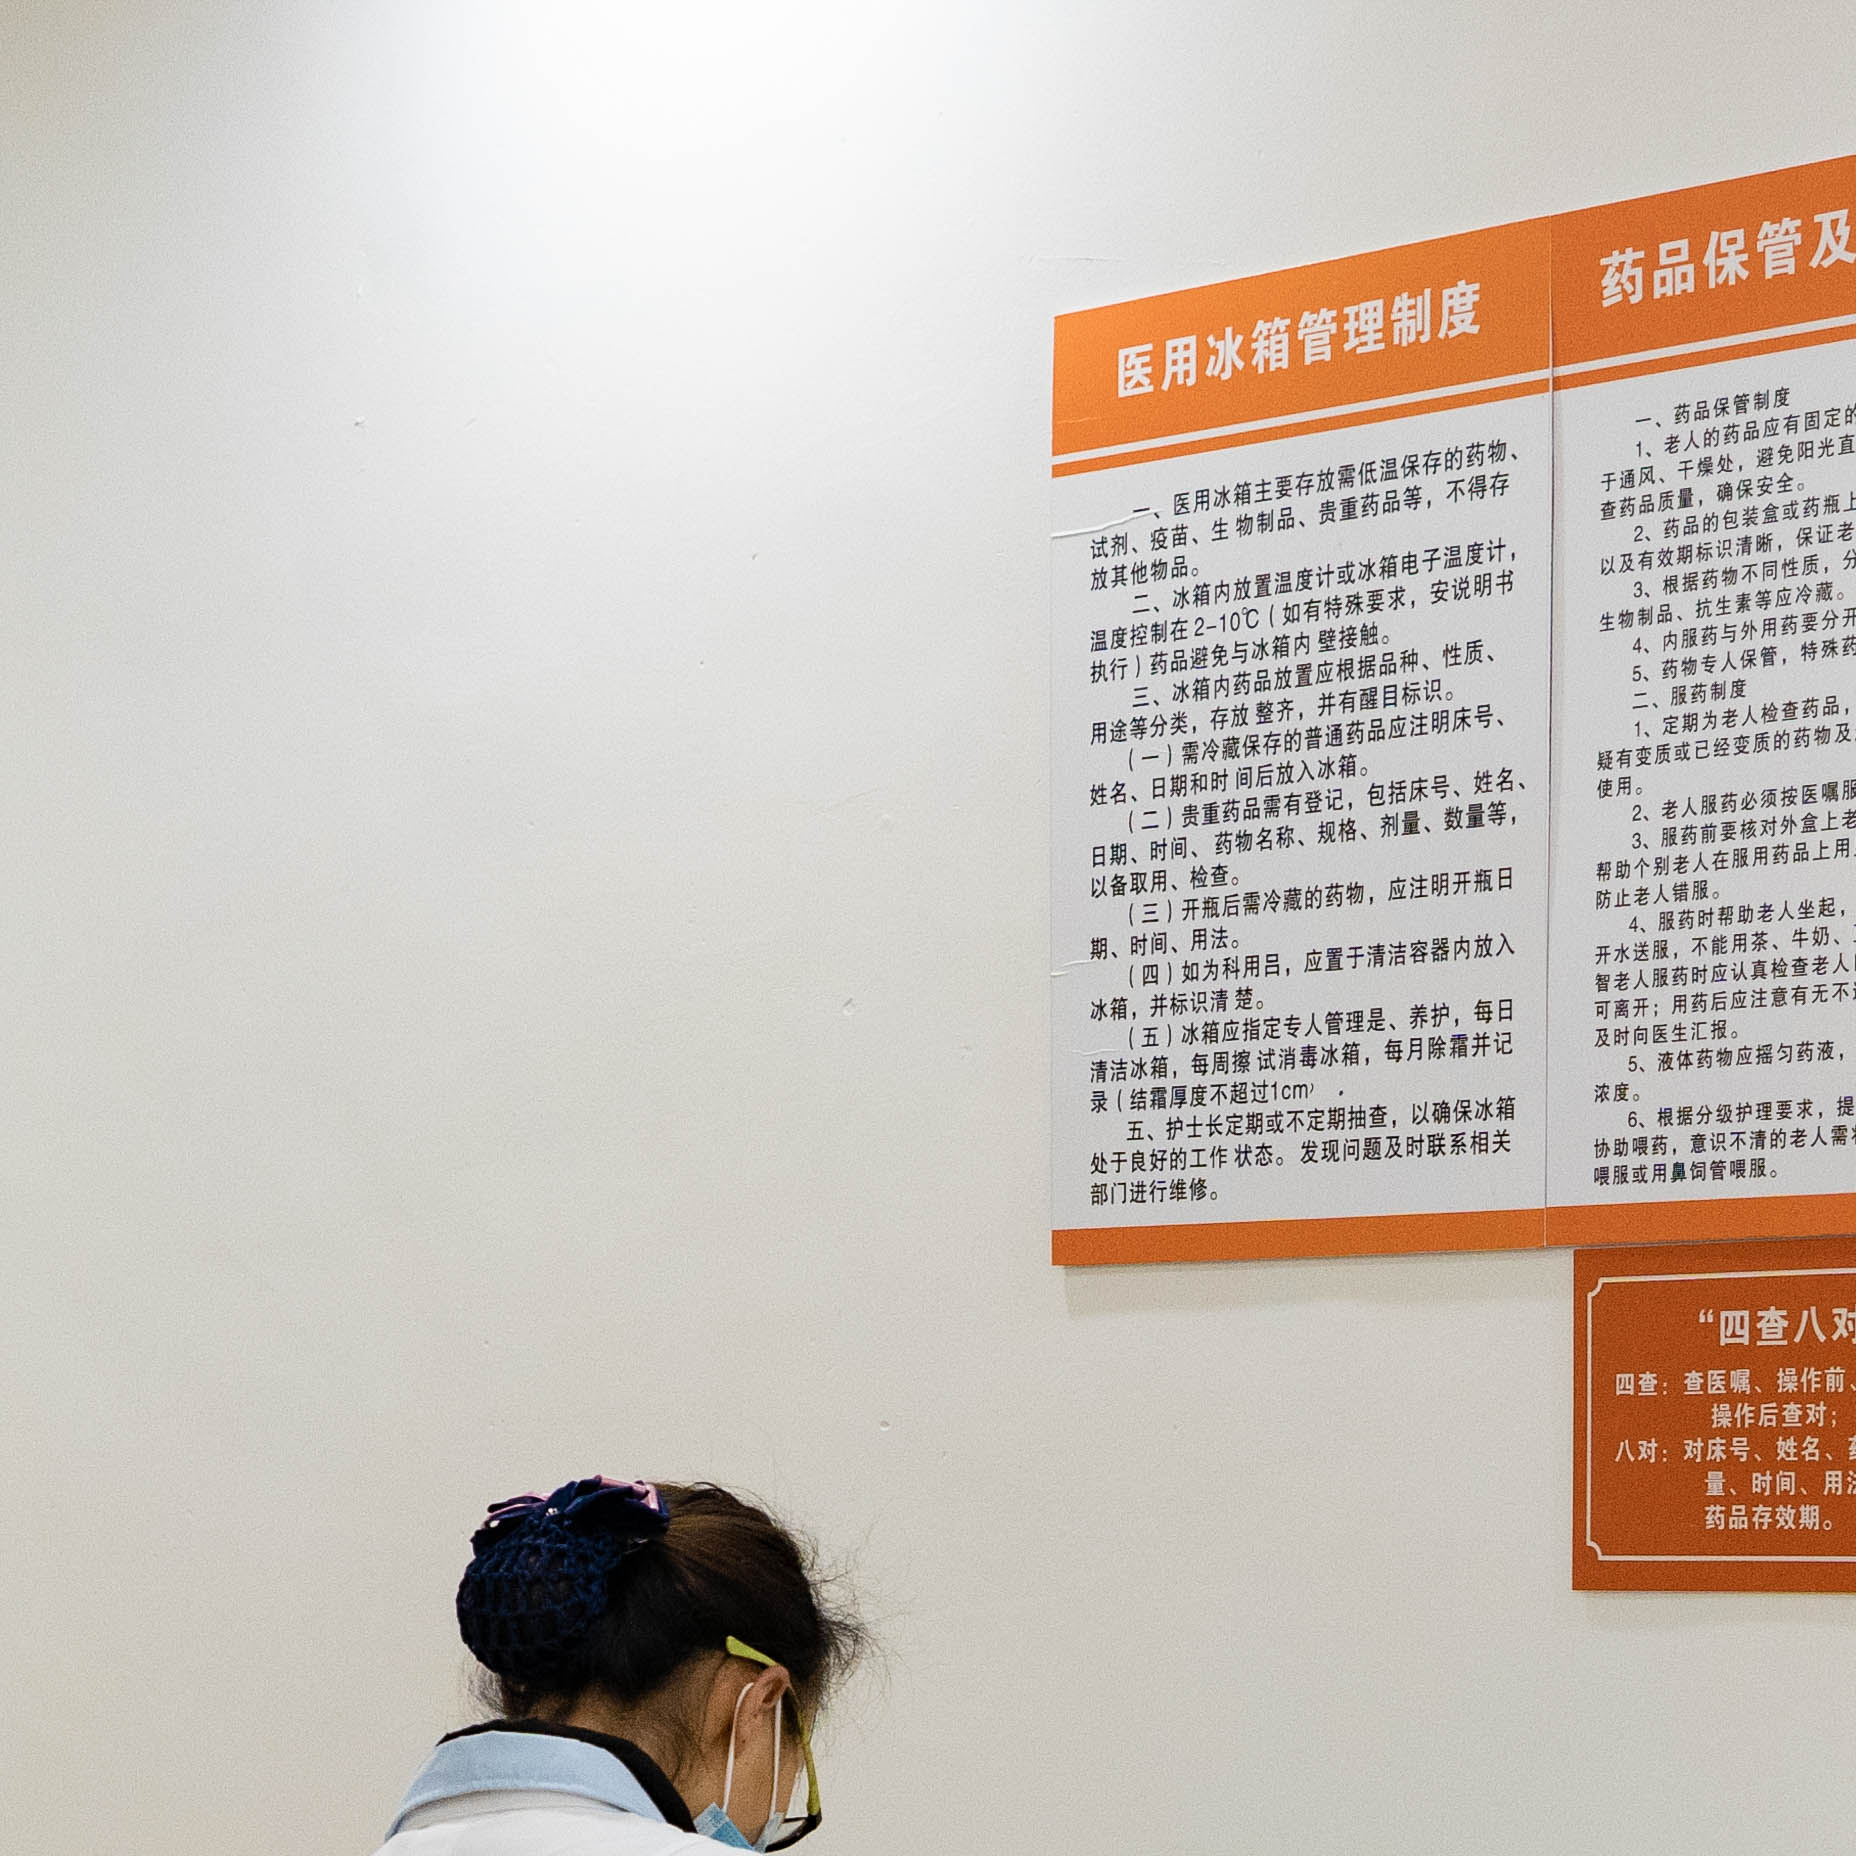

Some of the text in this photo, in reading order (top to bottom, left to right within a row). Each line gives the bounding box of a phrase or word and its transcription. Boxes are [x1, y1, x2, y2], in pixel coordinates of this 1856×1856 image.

[1116, 279, 1481, 398] 医用冰箱管理制度
[1633, 384, 1791, 429] 一、药品保管制度
[1598, 470, 1808, 522] 查药品质量，确保安全。
[1088, 553, 1202, 592] 放其他物品。
[1597, 579, 1847, 633] 生物制品、抗生素等应冷藏。
[1088, 619, 1393, 685] 执行）药品避免与冰箱内壁接触。
[1630, 676, 1747, 711] 二、服药制度
[1088, 751, 1372, 808] 姓名、日期和时间后放入冰箱。
[1595, 774, 1646, 800] 使用。
[1089, 861, 1243, 900] 以备取用、检查。
[1594, 878, 1723, 911] 防止老人错服。
[1088, 923, 1243, 961] 期、时间、用法。
[1088, 983, 1267, 1023] 冰箱，并标识清楚。
[1592, 1017, 1742, 1049] 及时向医生汇报。
[1592, 1080, 1643, 1104] 浓度。
[1592, 1155, 1781, 1187] 喂服或用鼻饲管喂服。
[1088, 1175, 1222, 1207] 部门进行维修。
[1704, 1503, 1834, 1532] 药品存效期。
